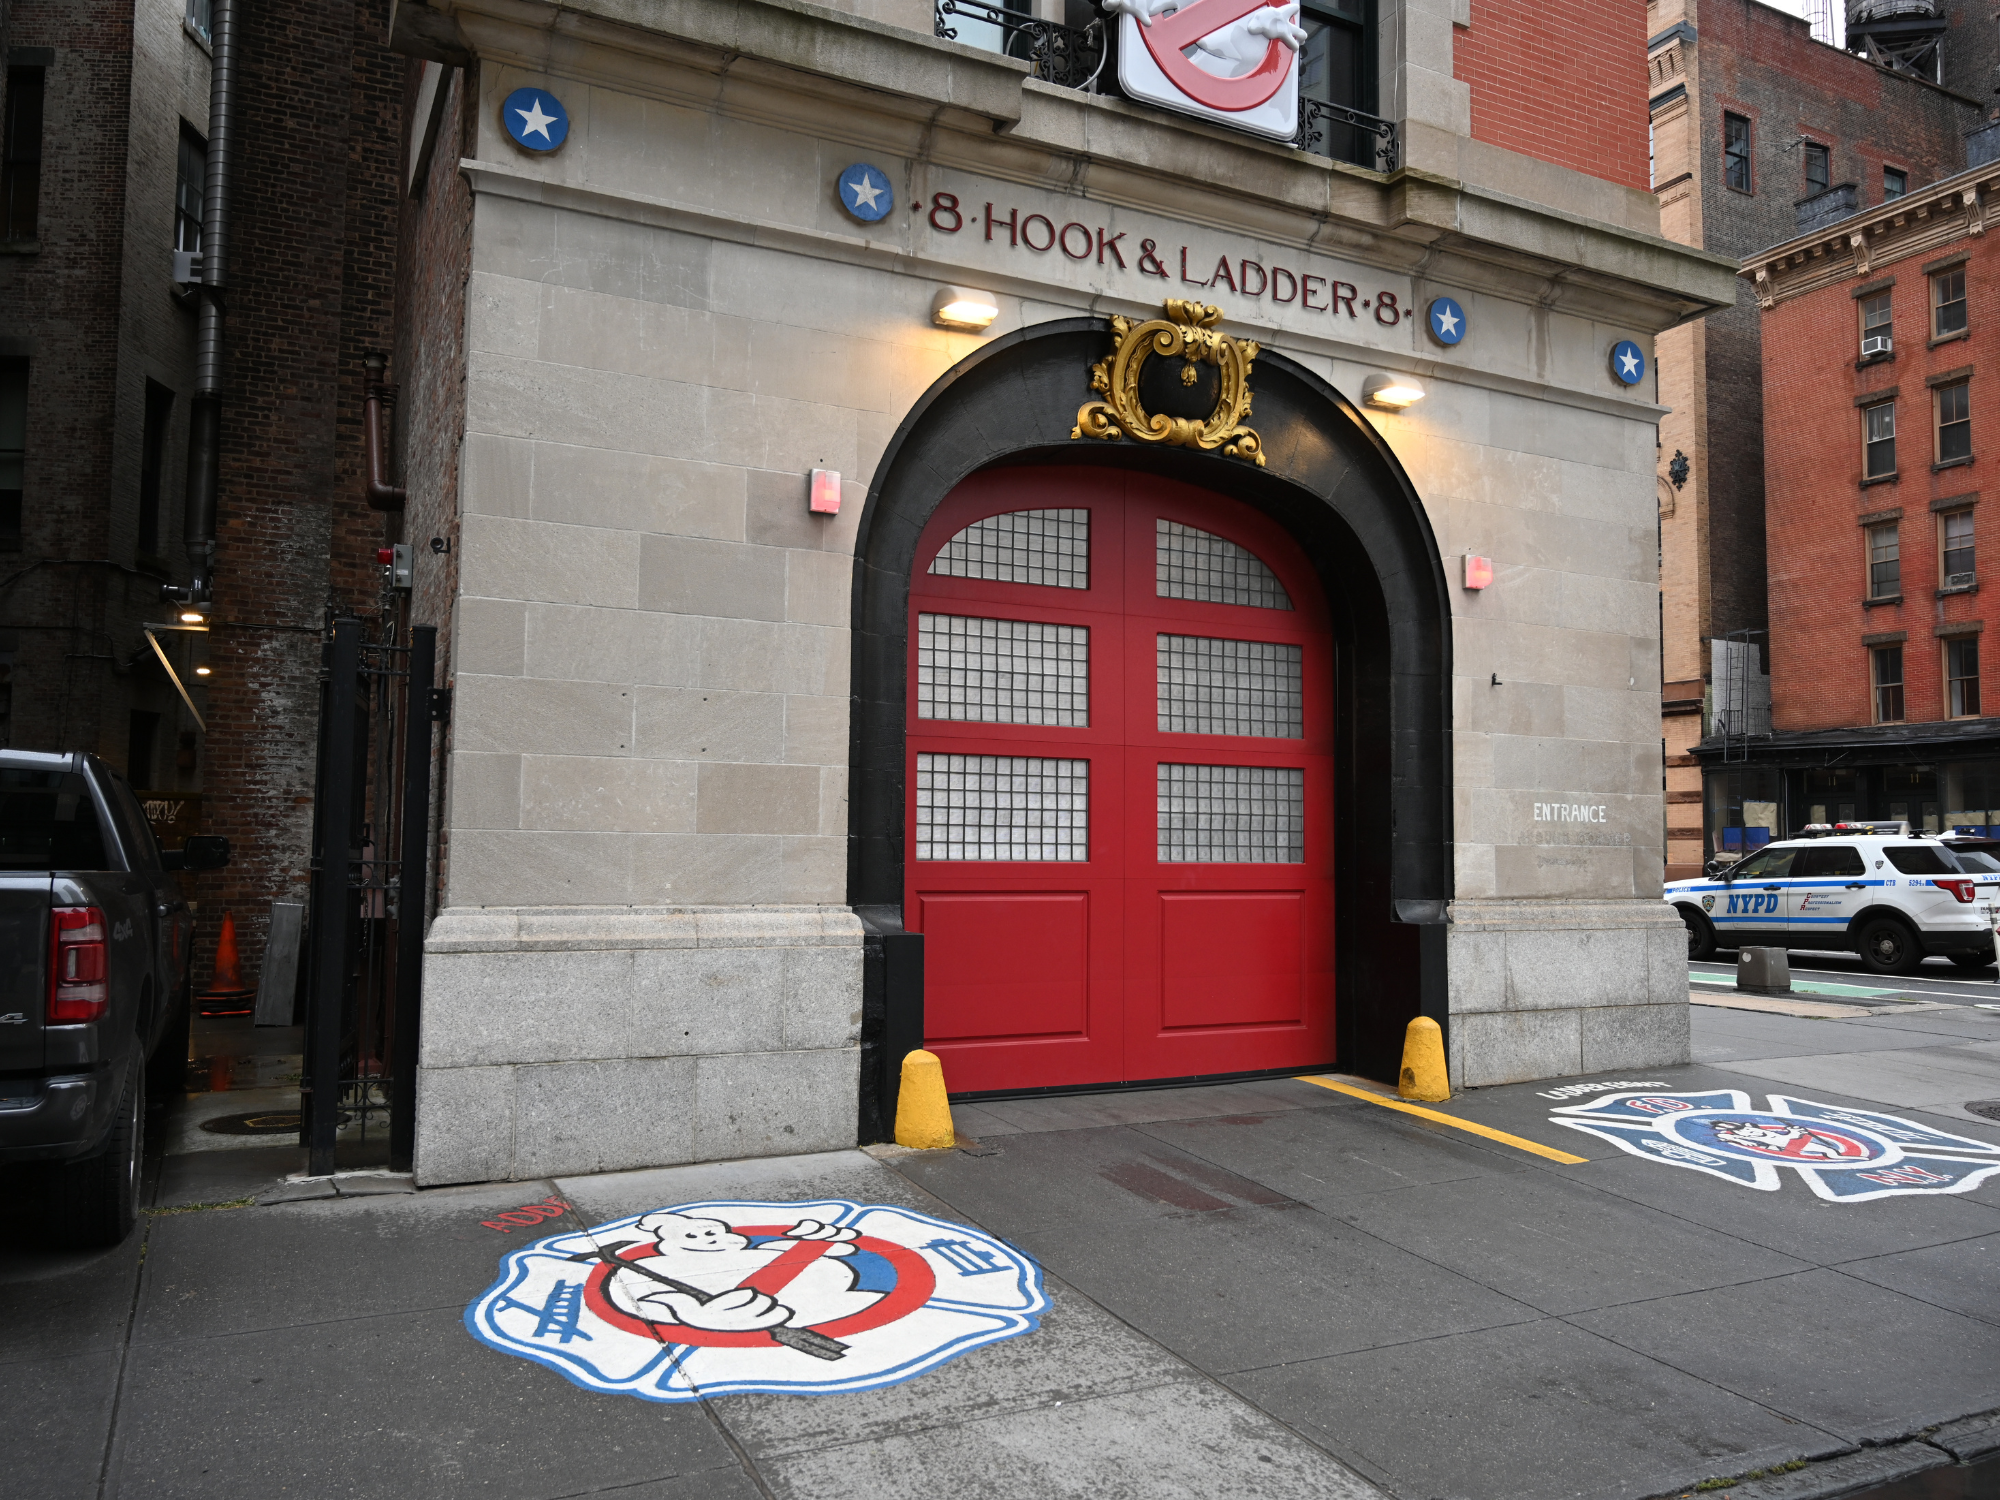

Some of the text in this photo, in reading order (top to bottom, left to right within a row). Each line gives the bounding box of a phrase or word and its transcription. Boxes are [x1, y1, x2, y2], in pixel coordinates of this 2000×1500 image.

[1139, 238, 1170, 278] &
[1533, 802, 1607, 823] ENTRANCE
[1726, 893, 1779, 914] NYPD
